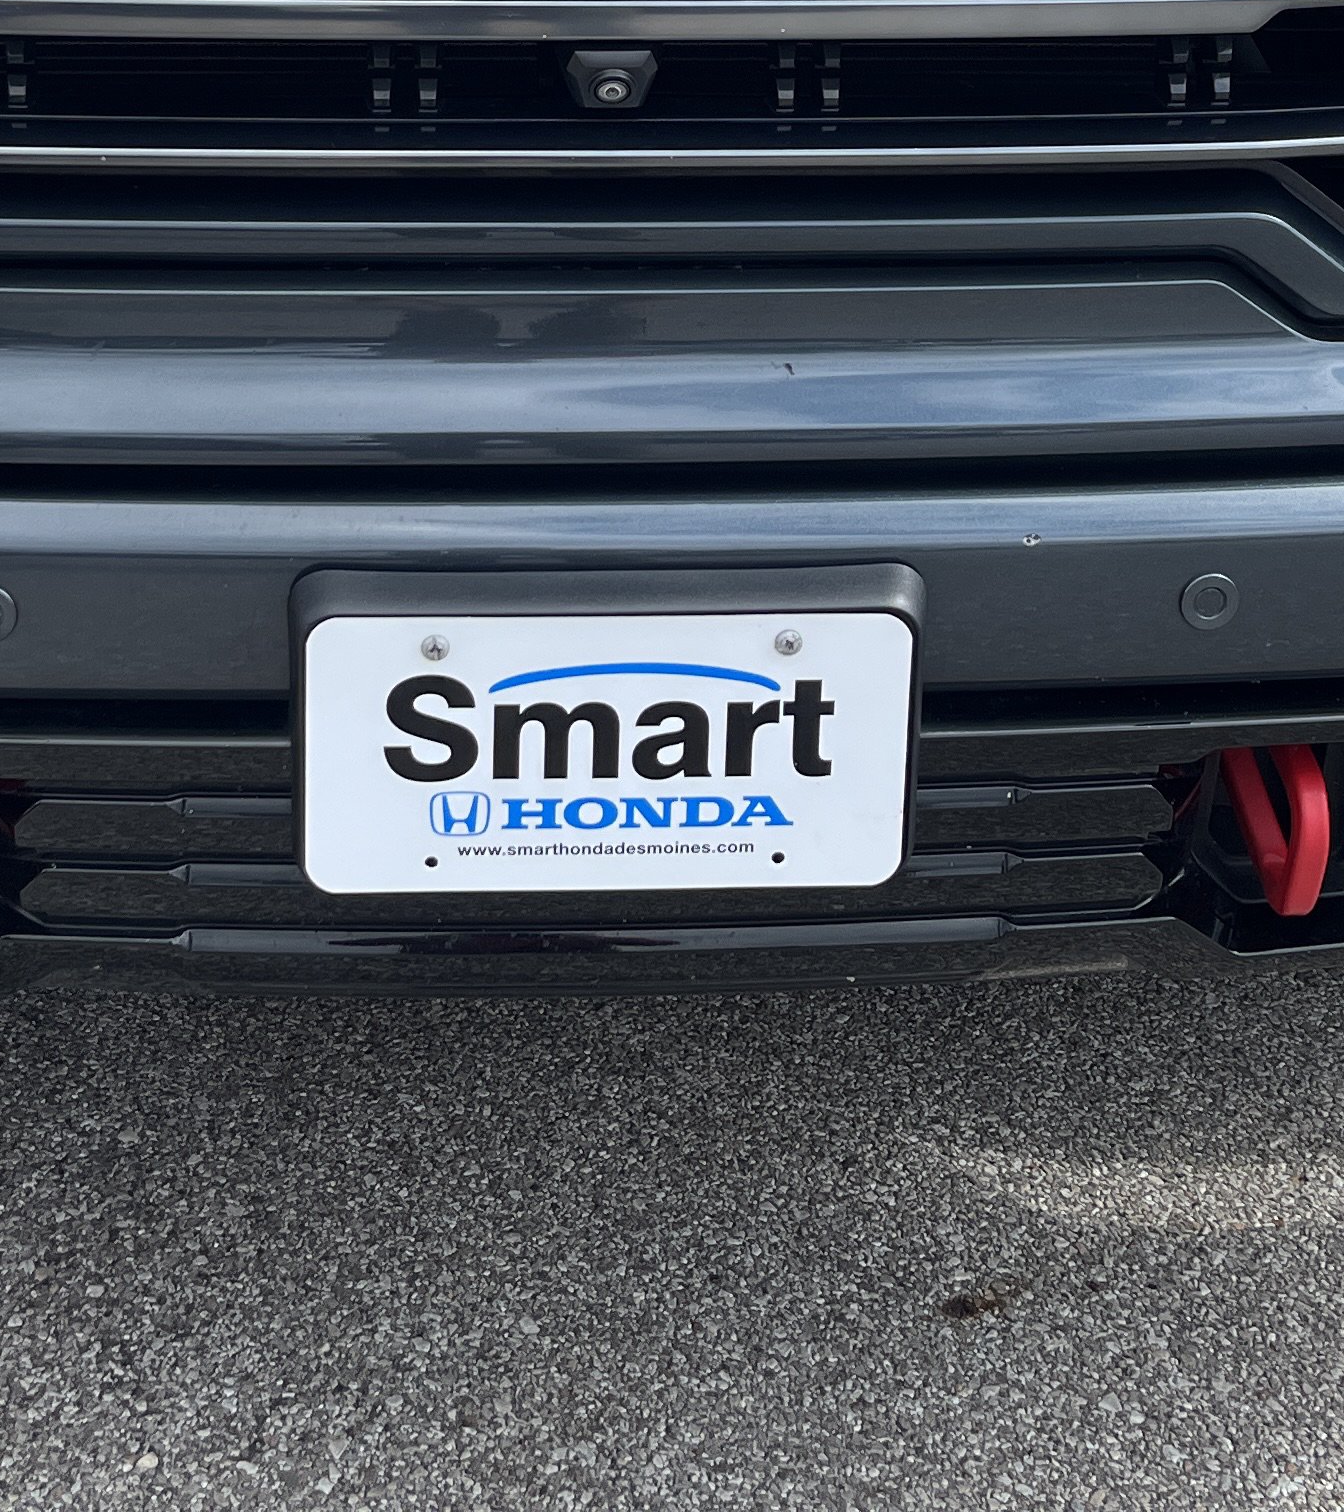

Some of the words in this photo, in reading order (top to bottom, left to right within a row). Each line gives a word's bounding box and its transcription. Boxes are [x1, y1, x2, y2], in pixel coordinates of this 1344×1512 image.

[383, 674, 836, 782] Smart
[500, 794, 794, 830] HONDA
[457, 840, 755, 858] www.smarthondadesmoines.com
